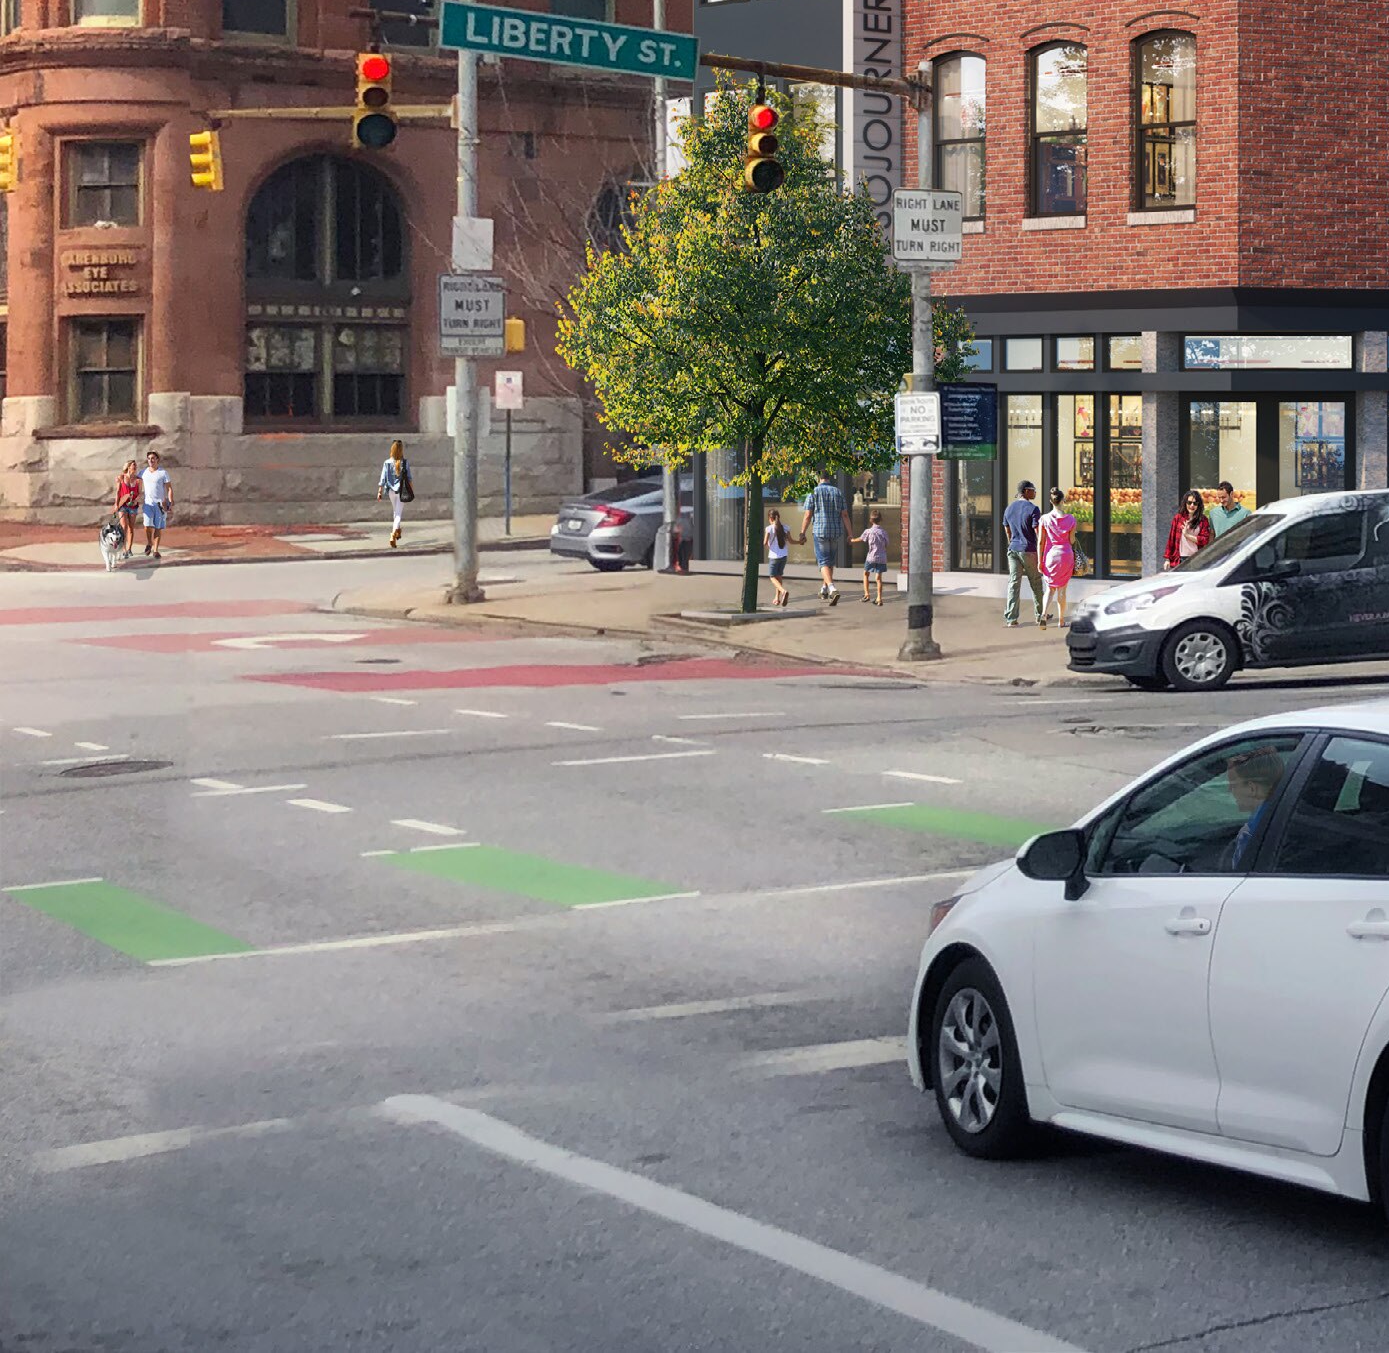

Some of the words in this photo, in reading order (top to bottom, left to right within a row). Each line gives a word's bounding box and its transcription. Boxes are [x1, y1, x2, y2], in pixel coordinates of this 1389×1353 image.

[466, 11, 628, 62] LIBERTY
[637, 39, 682, 68] ST.
[896, 197, 927, 209] RIGHT
[933, 199, 960, 211] LANE
[911, 218, 946, 232] MUST
[896, 240, 924, 251] TURN
[930, 241, 960, 252] RIGHT
[83, 266, 108, 278] EYE
[455, 299, 490, 312] MUST
[443, 318, 469, 328] TURN
[473, 318, 501, 328] RIGHT
[910, 405, 926, 414] NO
[900, 415, 936, 423] PARKING
